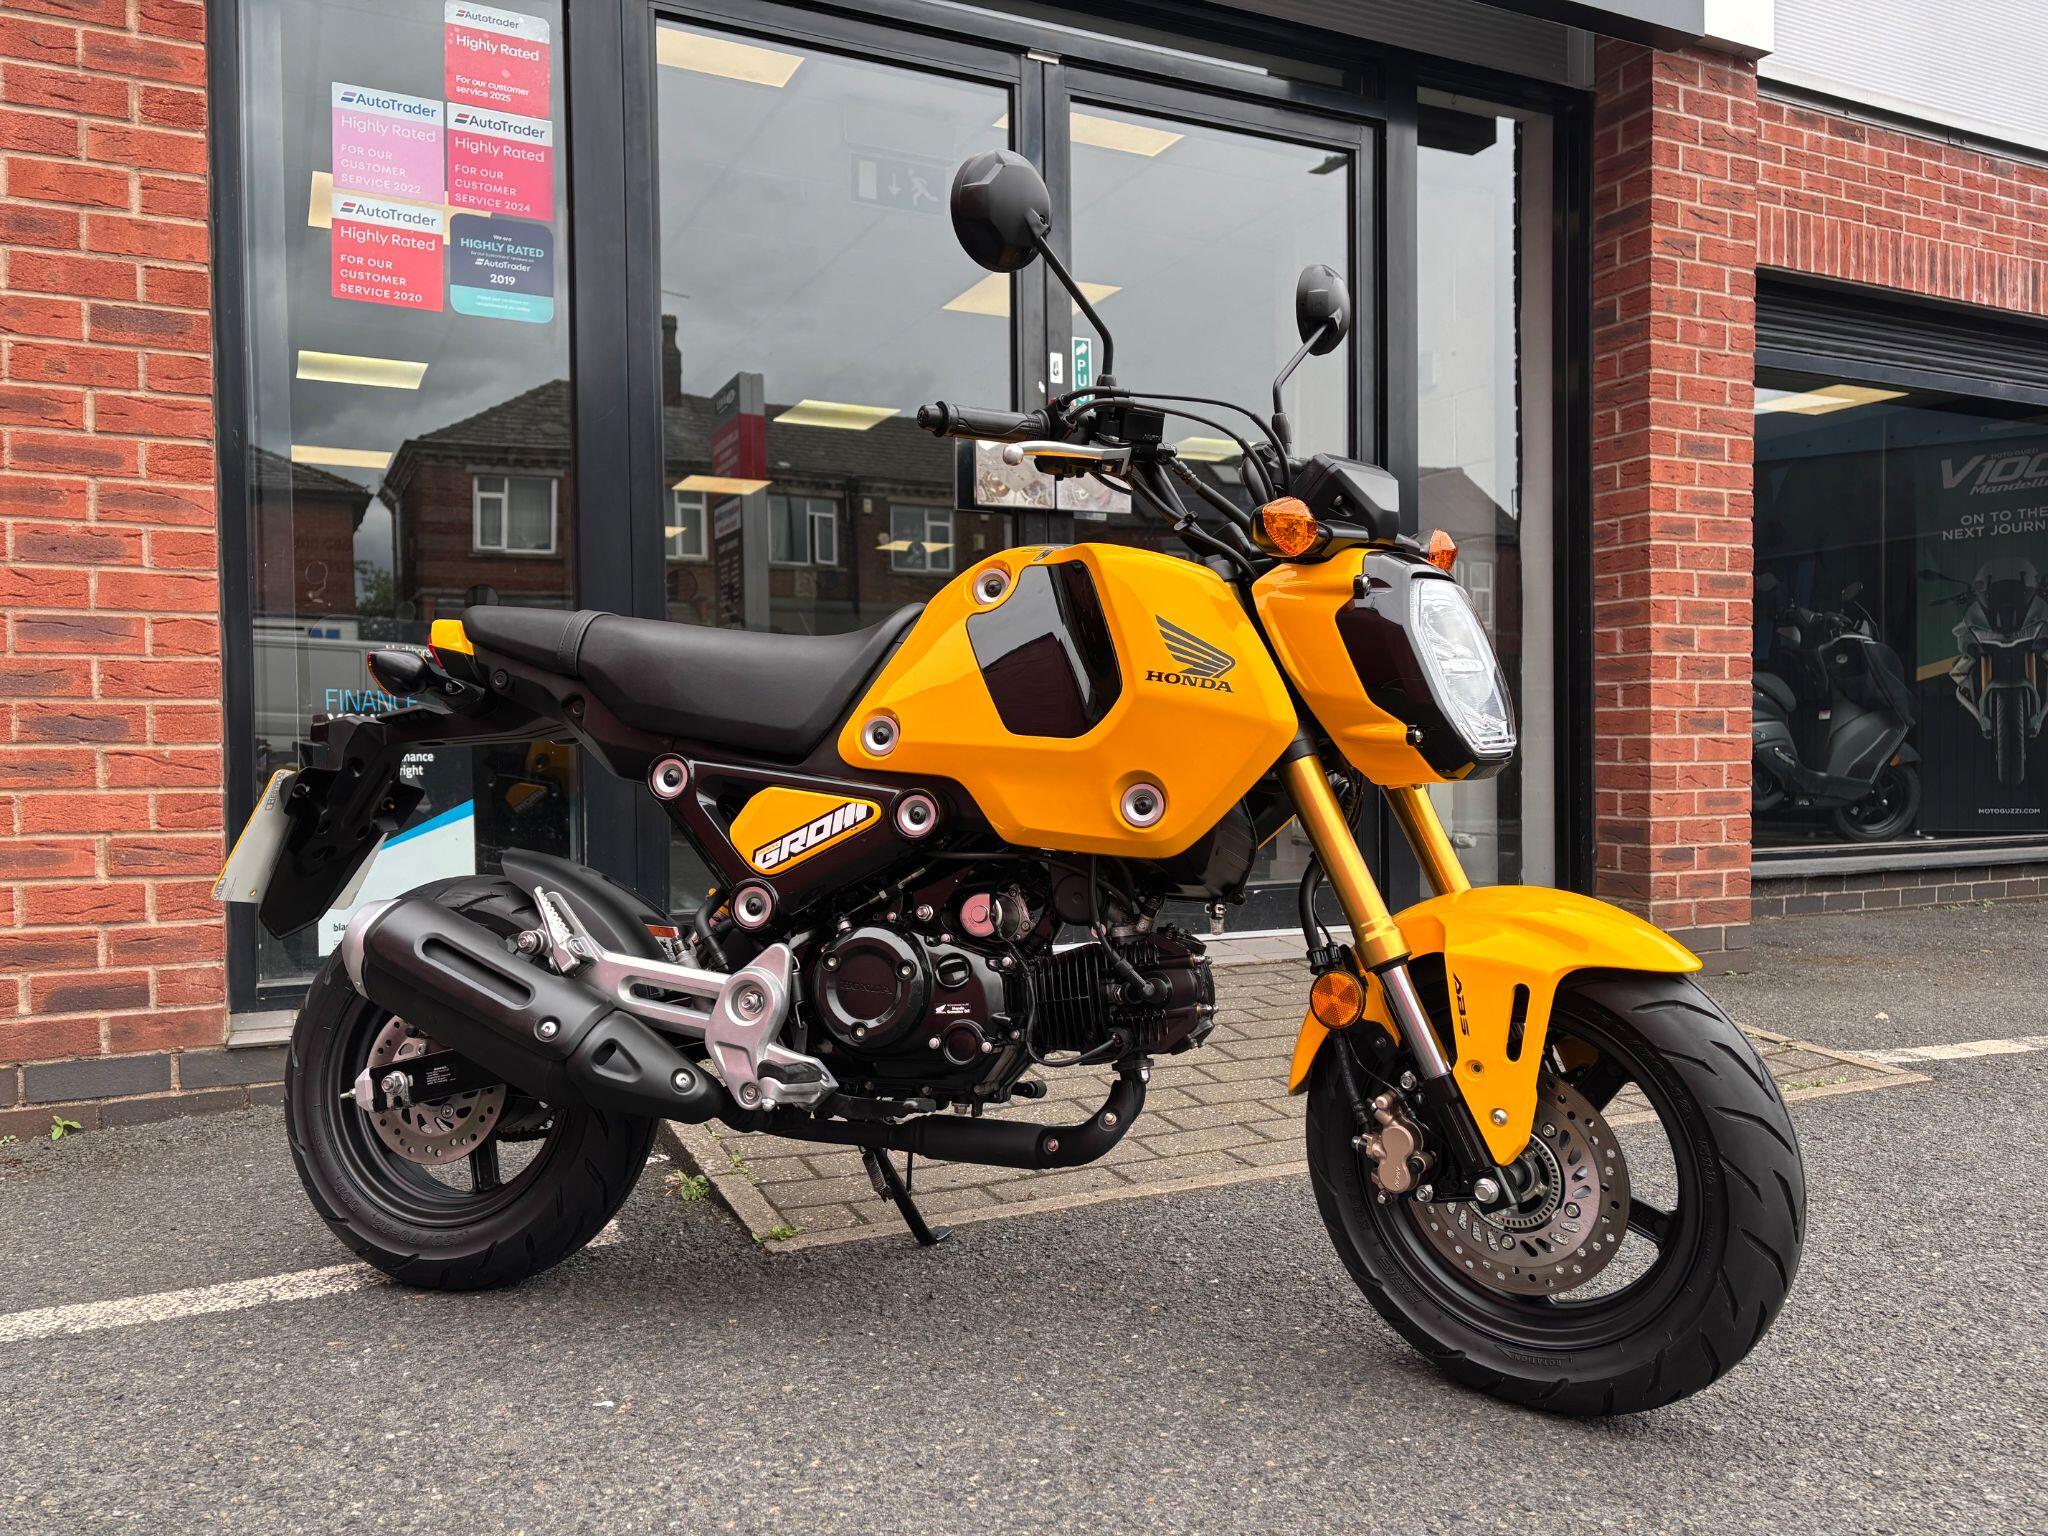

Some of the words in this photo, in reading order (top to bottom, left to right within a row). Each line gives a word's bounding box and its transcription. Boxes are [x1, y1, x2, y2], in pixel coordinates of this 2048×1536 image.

[464, 11, 519, 29] Autotrader
[456, 34, 498, 55] Highly
[500, 44, 540, 61] Rated
[455, 75, 471, 84] For
[472, 79, 487, 88] our
[488, 82, 530, 96] customer
[455, 85, 488, 98] service
[489, 91, 512, 102] 2025
[356, 93, 437, 118] AutoTrader
[341, 115, 389, 137] Highly
[392, 124, 436, 142] Rated
[469, 115, 545, 139] AutoTrader
[341, 144, 364, 156] FOR
[368, 148, 392, 160] OUR
[455, 137, 500, 157] Highly
[503, 145, 545, 163] Rated
[341, 158, 406, 177] CUSTOMER
[455, 164, 477, 175] FOR
[480, 168, 504, 180] OUR
[341, 173, 391, 189] SERVICE
[393, 182, 422, 194] 2022
[455, 178, 517, 197] CUSTOMER
[455, 193, 501, 208] SERVICE
[504, 201, 531, 213] 2024
[355, 204, 437, 227] AutoTrader
[340, 226, 388, 246] Highly
[391, 234, 436, 252] Rated
[460, 237, 505, 253] HIGHLY
[507, 244, 545, 258] RATED
[340, 254, 364, 266] FOR
[367, 258, 393, 269] OUR
[483, 259, 532, 273] AutoTrader
[340, 268, 407, 286] CUSTOMER
[490, 273, 516, 286] 2019
[340, 283, 391, 298] SERVICE
[393, 291, 423, 303] 2020
[1960, 512, 1985, 526] ON
[1990, 510, 2012, 522] TO
[2017, 506, 2048, 520] THE
[1942, 526, 1985, 541] NEXT
[1145, 670, 1234, 693] HONDA
[1978, 807, 2041, 815] MOTOGUZZI.COM
[754, 802, 868, 870] GROM
[1453, 972, 1470, 1037] ABS
